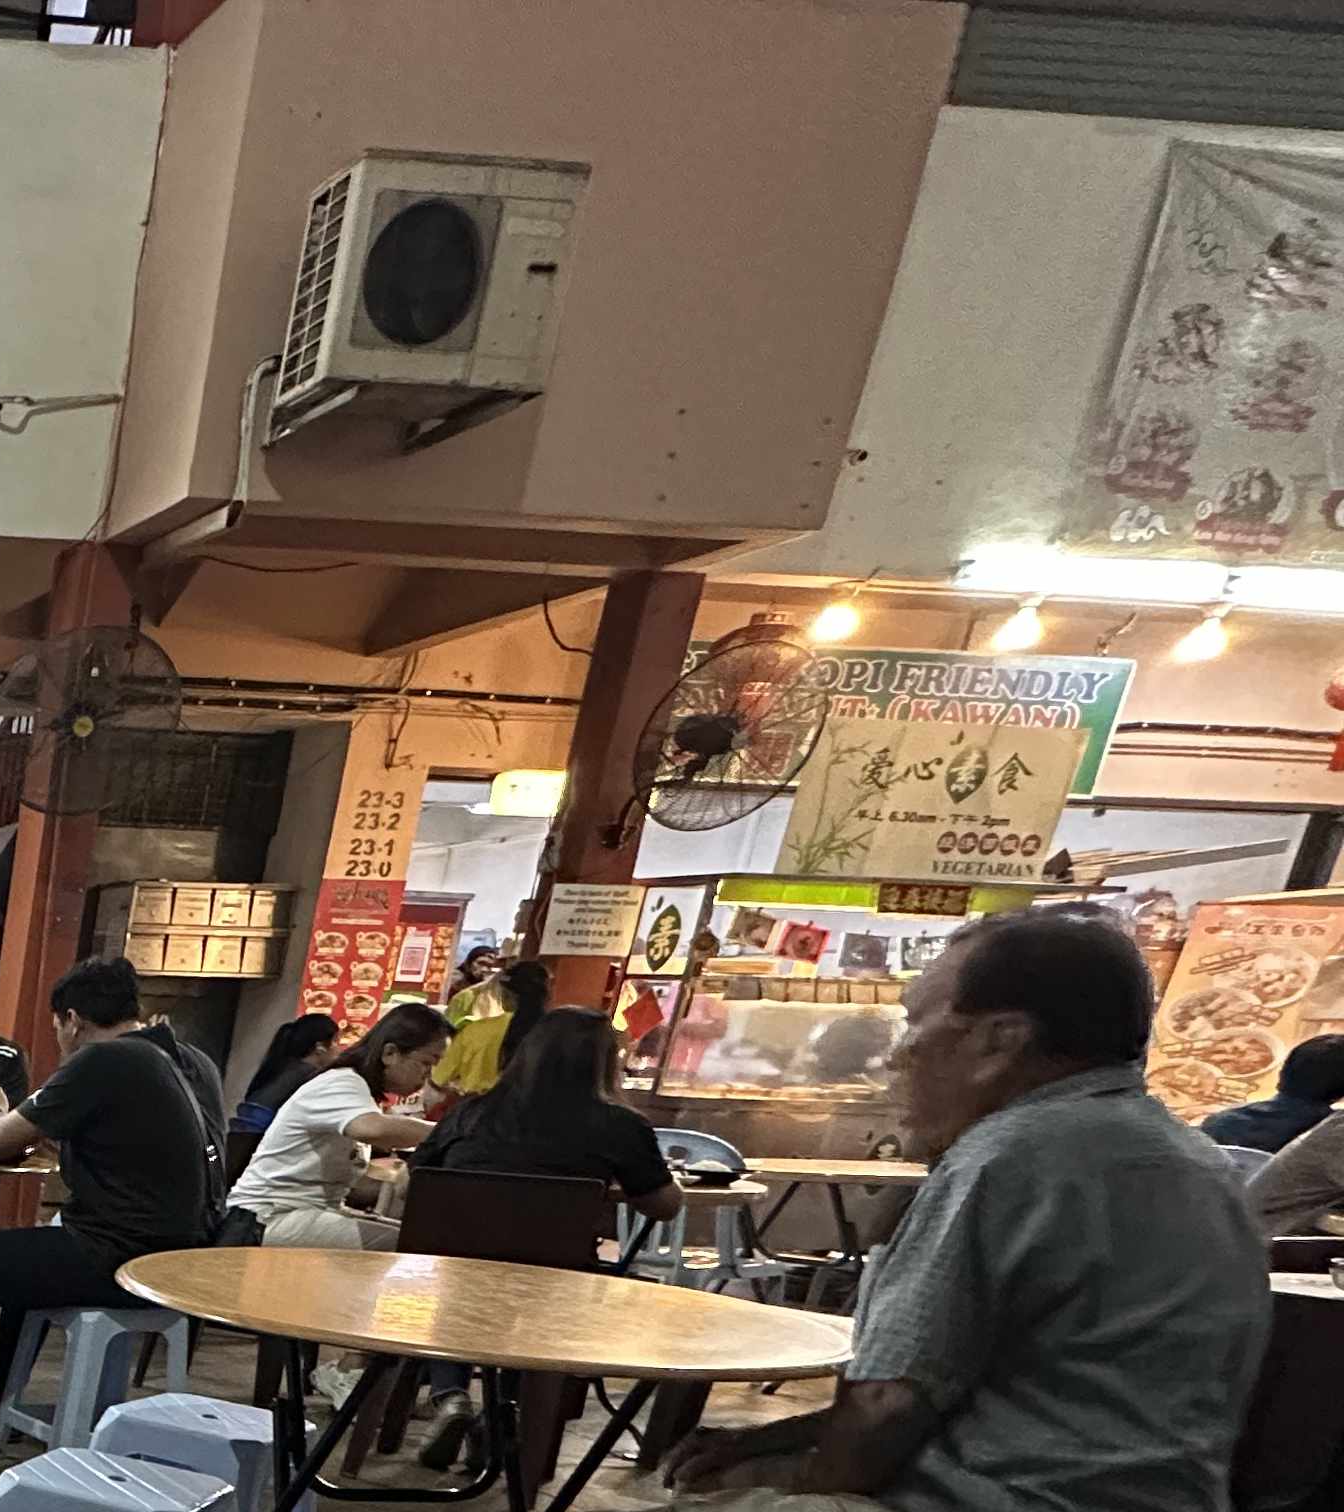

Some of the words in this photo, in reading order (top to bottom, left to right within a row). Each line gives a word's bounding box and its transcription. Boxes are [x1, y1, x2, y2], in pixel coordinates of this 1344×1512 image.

[889, 660, 1111, 704] FRIENDLY
[357, 790, 405, 809] 23-3
[931, 860, 1035, 878] VEGETARIAN
